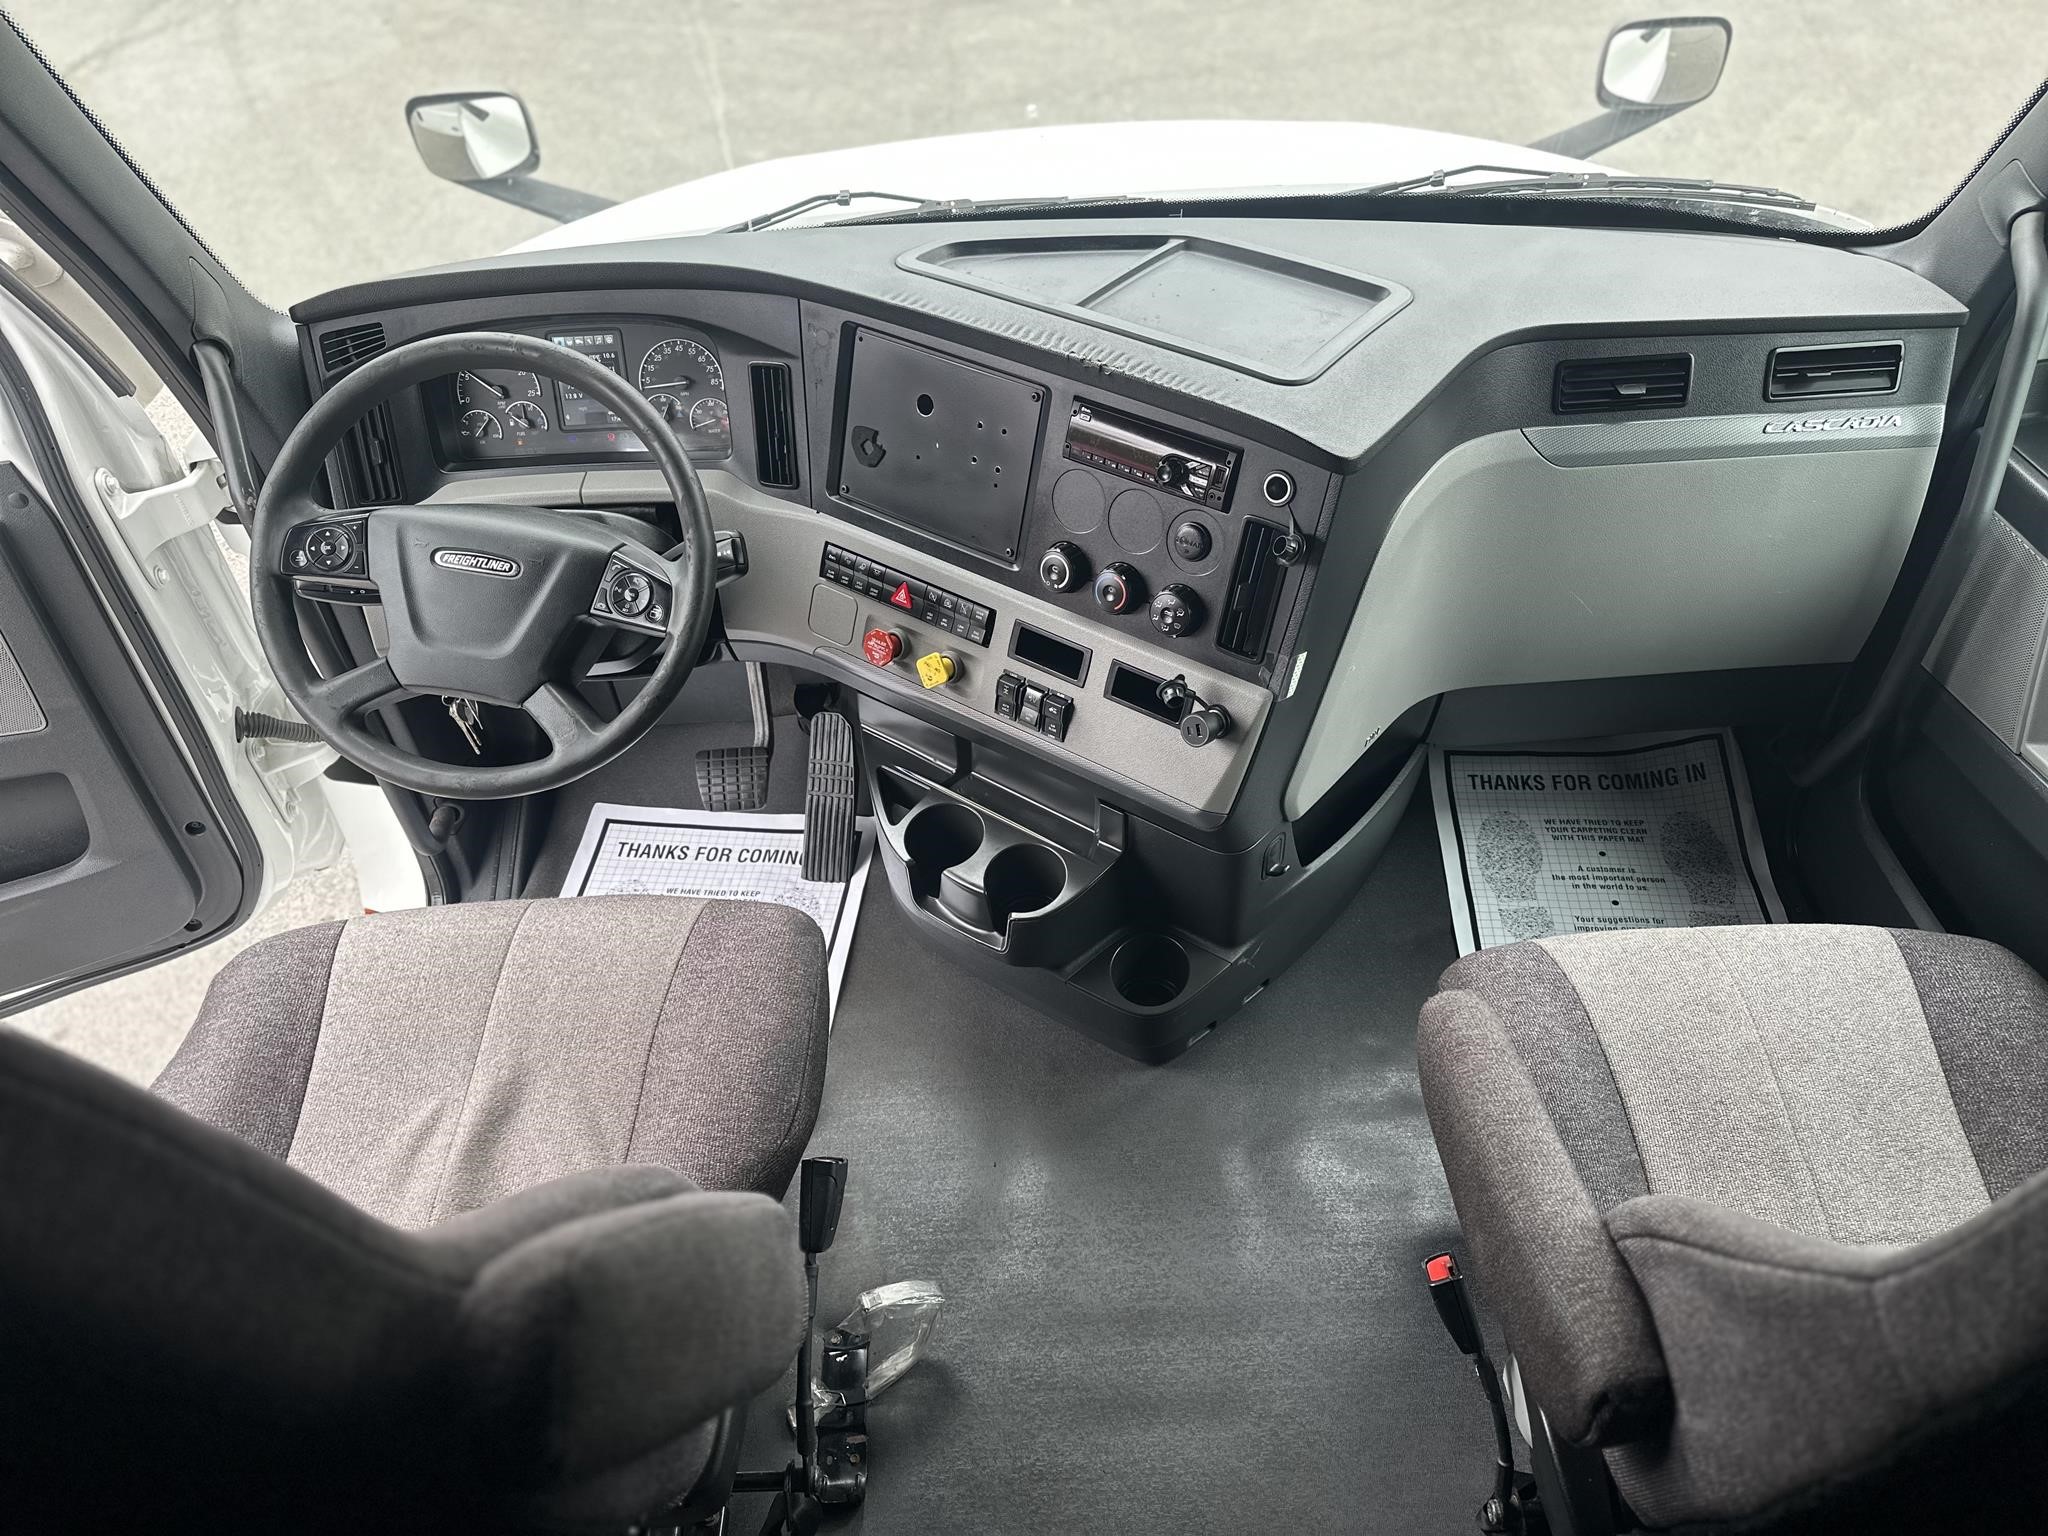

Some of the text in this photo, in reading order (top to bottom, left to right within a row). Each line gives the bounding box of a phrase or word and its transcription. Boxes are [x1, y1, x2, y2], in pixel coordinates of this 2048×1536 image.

[1762, 415, 1901, 434] CASCADIA
[442, 553, 511, 572] FREIGHTLINER
[1467, 762, 1707, 791] THANKS FOR COMING IN
[1571, 826, 1618, 834] CARPETING
[617, 842, 690, 861] THANKS
[694, 846, 732, 863] FOR
[1637, 876, 1666, 884] person
[1597, 916, 1650, 925] suggestions
[1652, 917, 1665, 925] for
